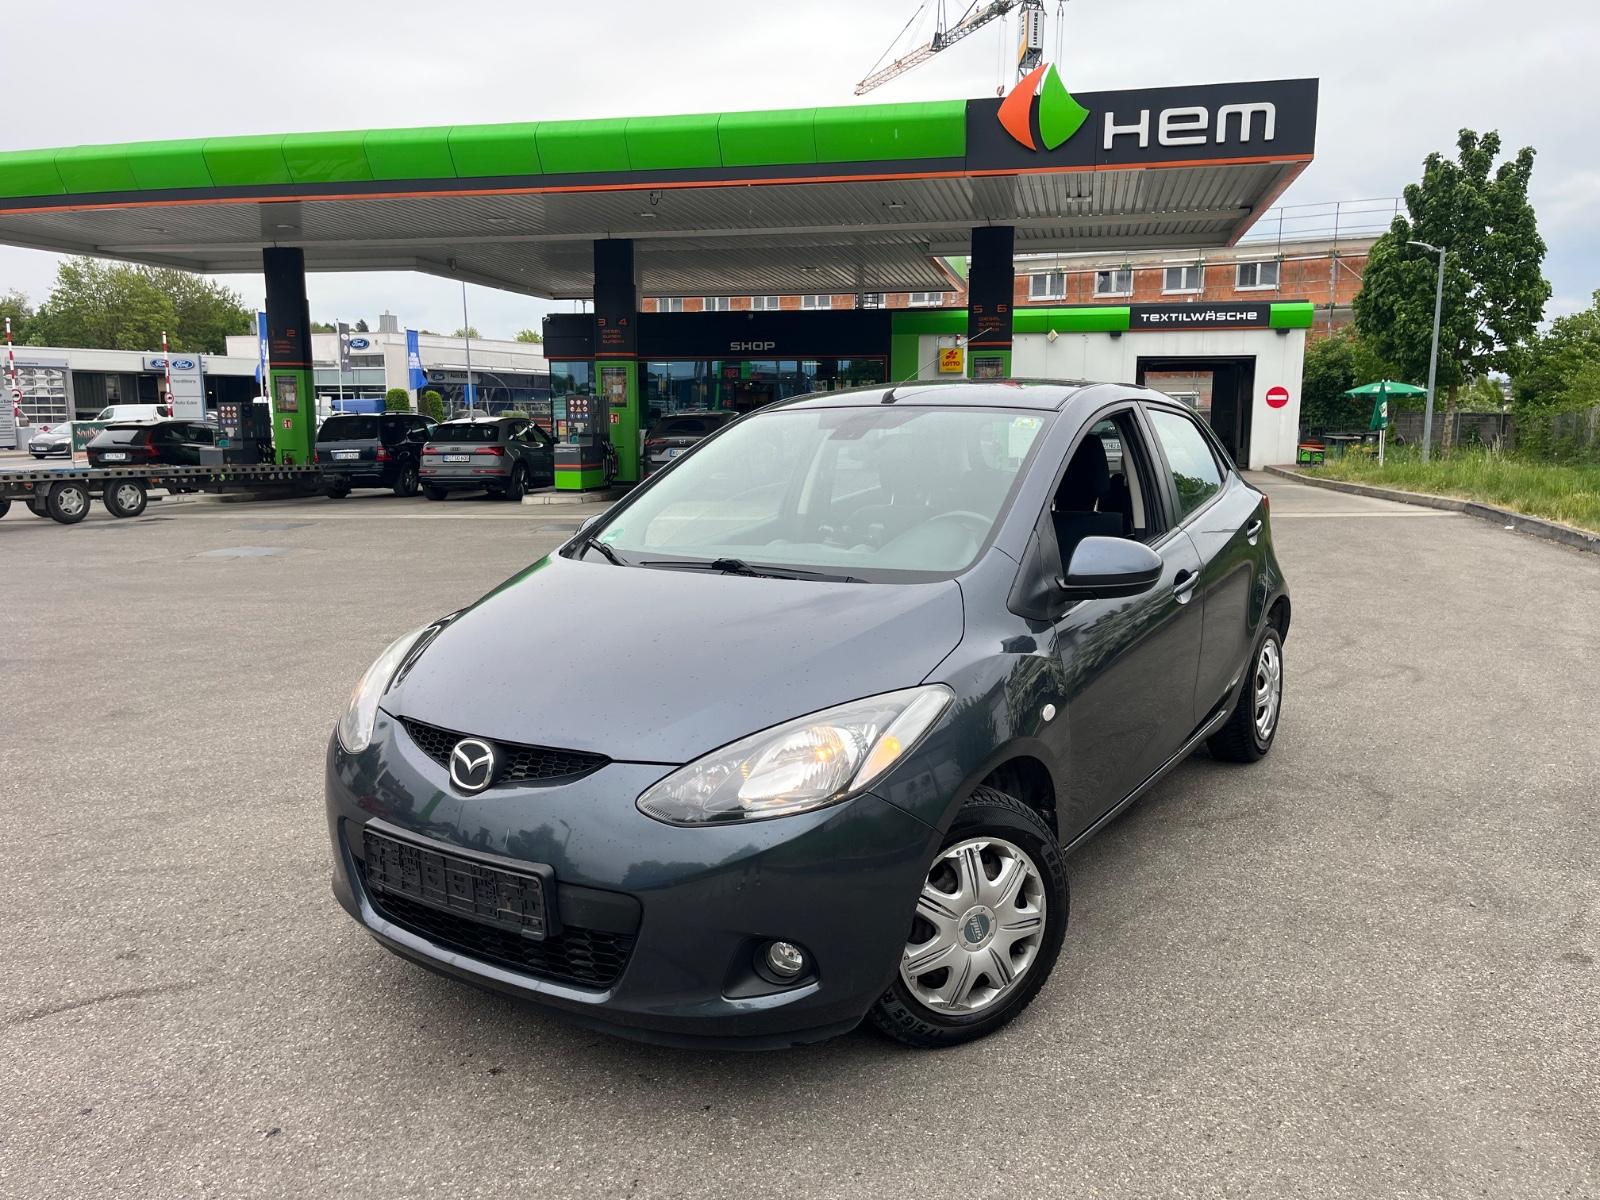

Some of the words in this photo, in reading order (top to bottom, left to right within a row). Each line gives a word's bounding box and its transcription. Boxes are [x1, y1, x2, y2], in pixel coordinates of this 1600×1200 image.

[973, 304, 984, 314] 5
[996, 304, 1008, 313] 6
[1140, 310, 1258, 322] TEXTILWÄSCHE
[597, 318, 606, 327] 3
[617, 318, 629, 327] 4
[286, 329, 297, 337] 2
[730, 341, 776, 351] SHOP
